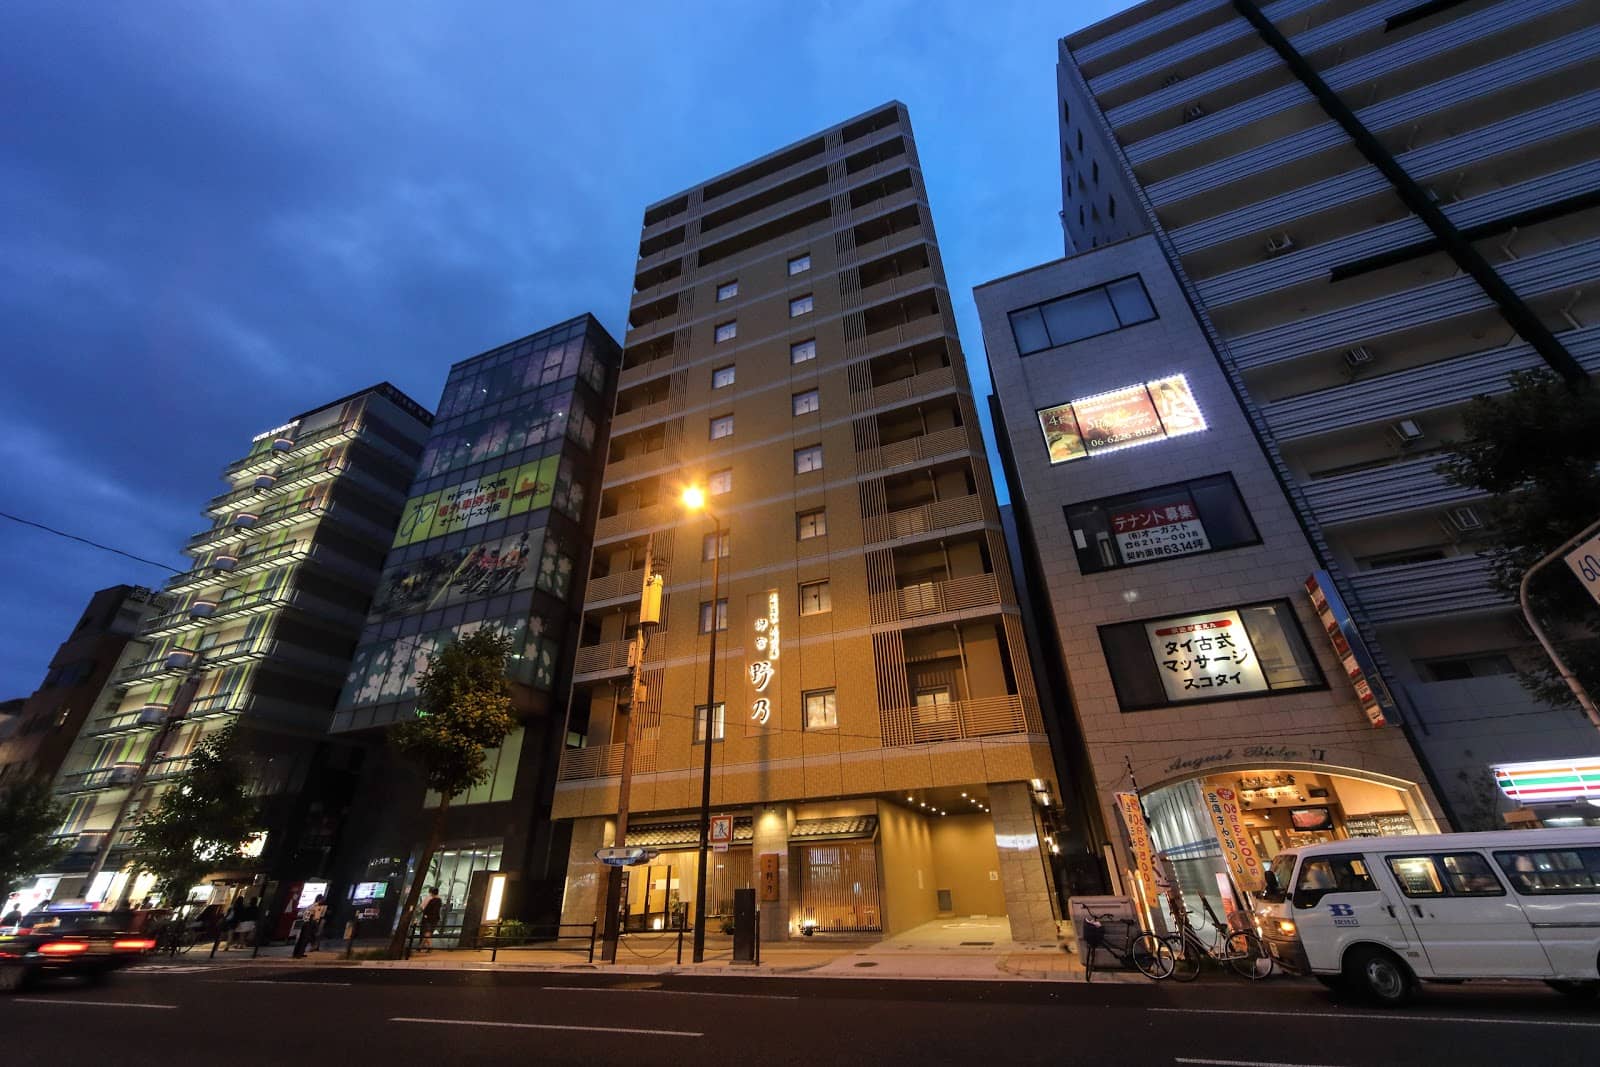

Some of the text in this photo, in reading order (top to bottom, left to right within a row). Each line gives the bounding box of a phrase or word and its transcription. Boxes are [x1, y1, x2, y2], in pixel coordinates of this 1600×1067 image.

[1115, 504, 1193, 530] テナント募集
[1127, 538, 1204, 560] 契約面積63.14坪
[1165, 632, 1236, 655] タイ古式
[1162, 648, 1248, 672] マッサージ
[1183, 672, 1241, 690] スコタイ
[1164, 749, 1233, 774] August
